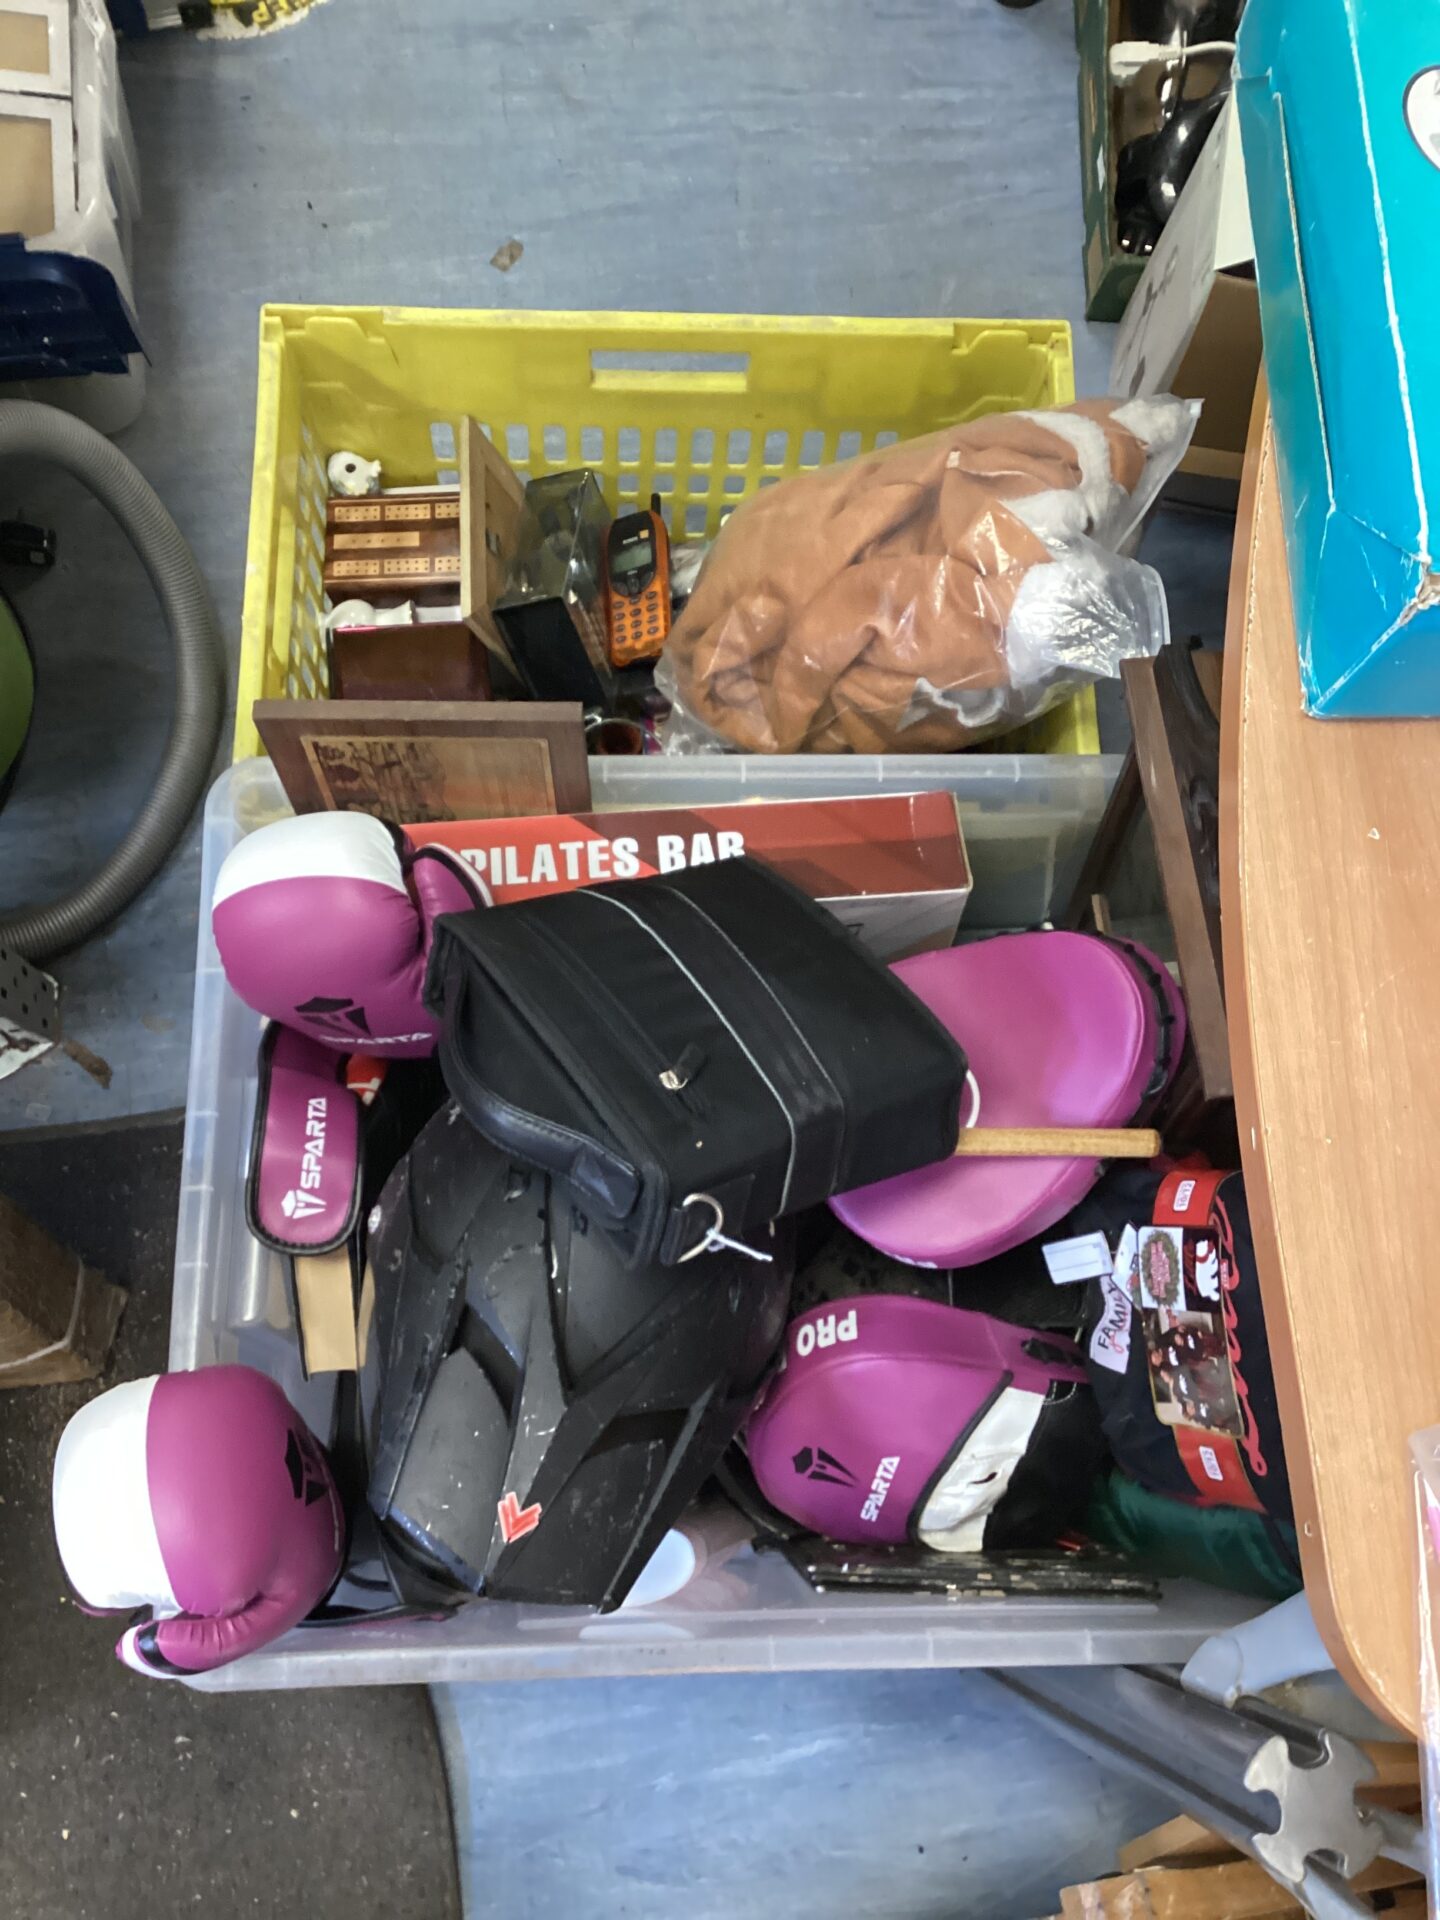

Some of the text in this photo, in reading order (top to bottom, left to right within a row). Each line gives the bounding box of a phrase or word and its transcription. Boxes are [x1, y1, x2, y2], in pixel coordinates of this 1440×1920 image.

[459, 831, 746, 886] PILATES BAR
[299, 1096, 328, 1190] SPARTA
[796, 1309, 858, 1357] PRO
[1097, 1281, 1127, 1350] FAMILY
[859, 1455, 901, 1523] SPARTA
